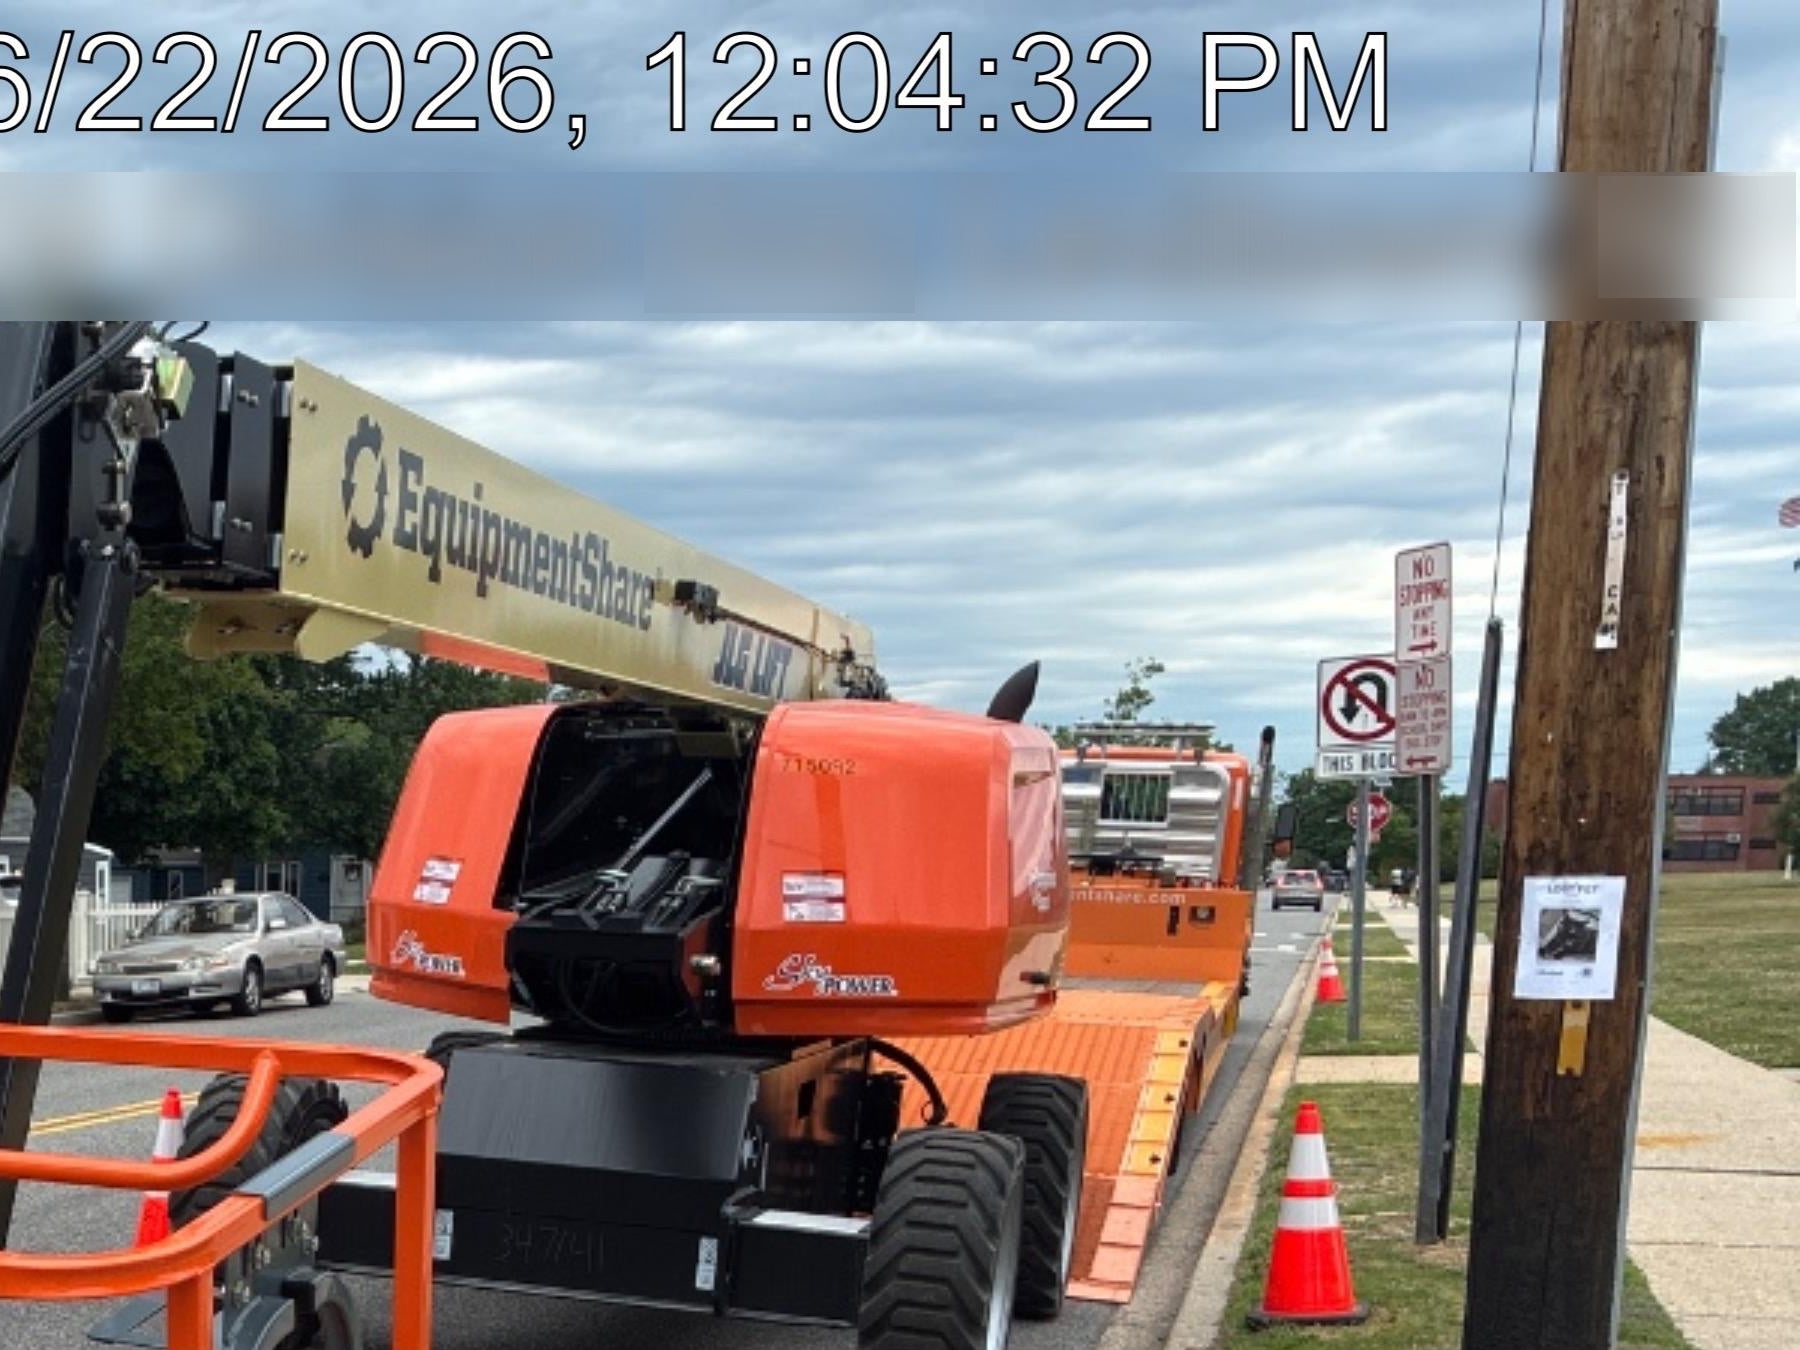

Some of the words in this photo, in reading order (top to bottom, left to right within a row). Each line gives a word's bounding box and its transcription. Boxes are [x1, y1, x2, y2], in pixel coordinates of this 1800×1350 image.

[392, 447, 656, 631] EquipmentShare
[1413, 557, 1434, 579] NO
[1400, 580, 1448, 606] STOPPING
[714, 622, 753, 690] JLG
[1414, 667, 1434, 689] NO
[1323, 755, 1353, 772] THIS
